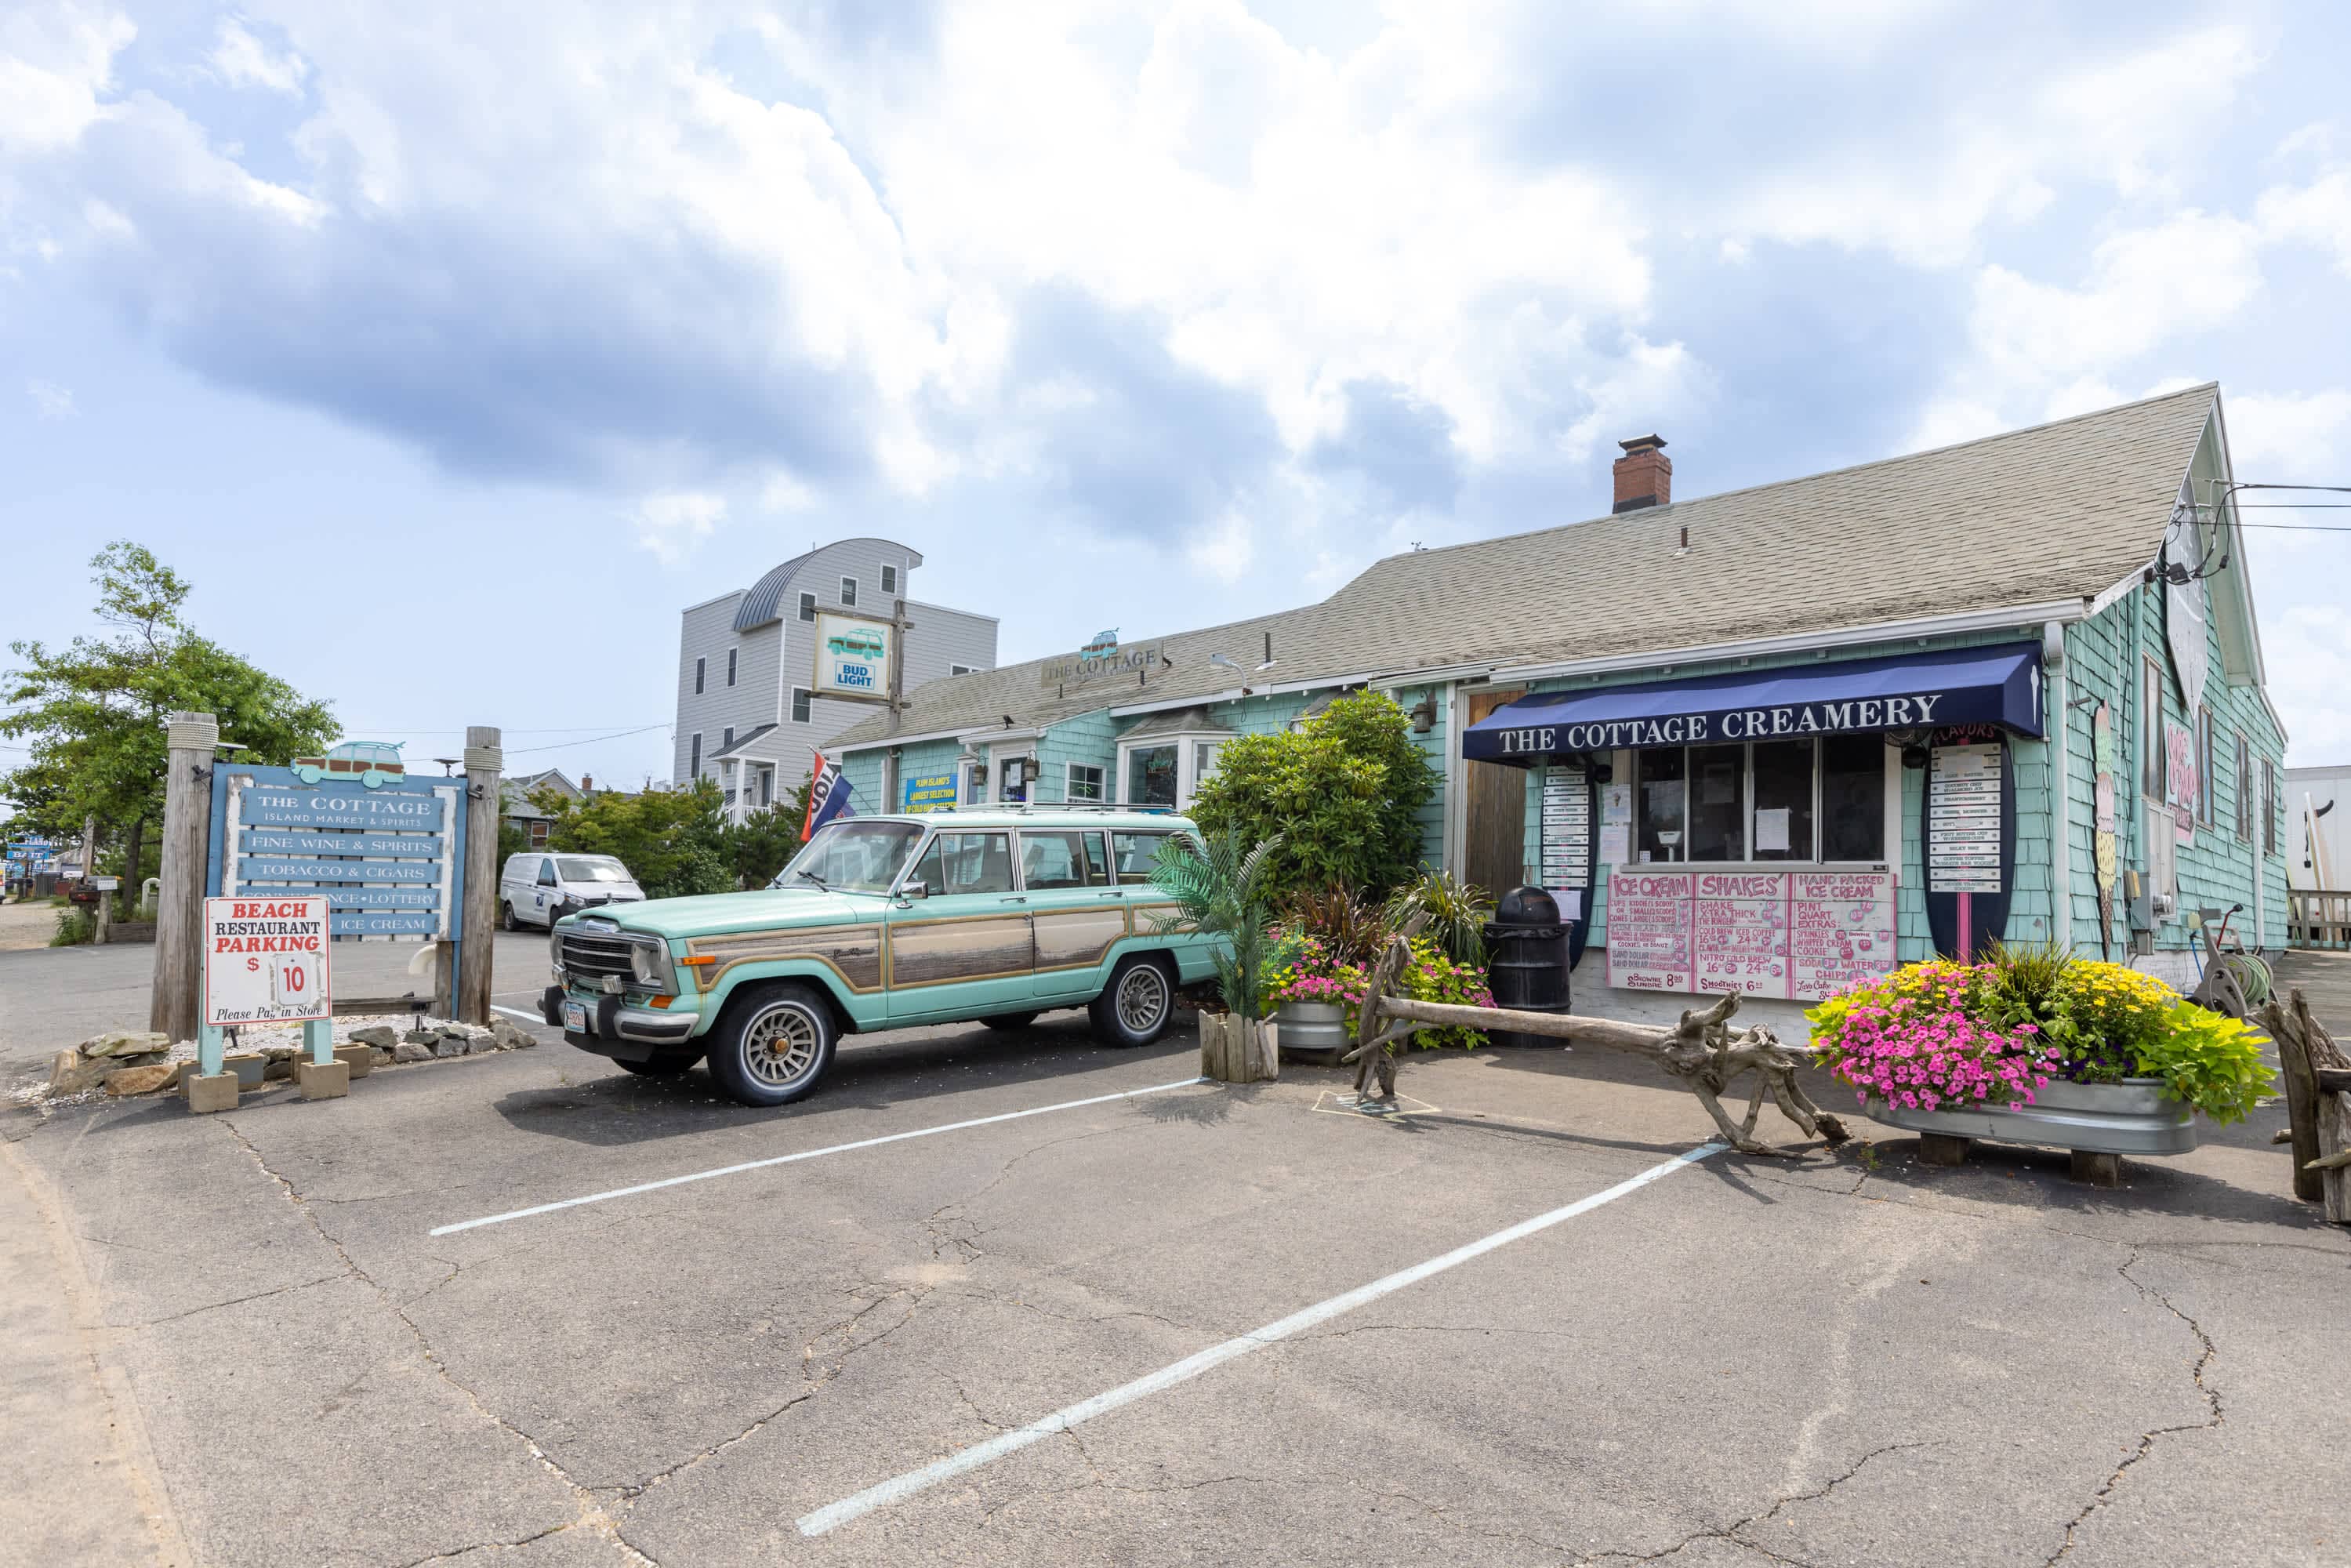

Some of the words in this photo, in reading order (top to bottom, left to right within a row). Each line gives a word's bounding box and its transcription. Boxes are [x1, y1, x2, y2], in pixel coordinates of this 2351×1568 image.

[843, 664, 868, 676] BUD
[1047, 664, 1071, 679] THE
[1076, 649, 1156, 675] COTTAGE
[837, 673, 873, 687] LIGHT
[1499, 728, 1555, 753] THE
[1568, 715, 1707, 749] COTTAGE
[1722, 695, 1942, 739] CREAMERY
[916, 779, 928, 787] PLUM
[928, 776, 950, 786] ISLAND'S
[910, 790, 929, 801] LARGEST
[929, 789, 955, 799] SELECTION
[258, 797, 299, 808] THE
[310, 797, 431, 815] COTTAGE
[265, 814, 310, 822] ISLAND
[316, 815, 364, 824] MARKET
[382, 818, 422, 826] SPIRITS
[252, 837, 293, 848] FINE
[301, 838, 346, 850] WINE
[353, 840, 364, 851] &
[372, 841, 433, 852] SPIRITS
[262, 865, 343, 877] TOBACCO
[348, 867, 358, 877] &
[366, 866, 425, 878] CIGARS
[1701, 875, 1780, 897] SHAKES
[1799, 875, 1837, 886] HAND
[1839, 875, 1885, 885] PACKED
[1640, 876, 1689, 898] CREAM
[1805, 886, 1827, 898] ICE
[1831, 885, 1874, 898] CREAM
[368, 893, 434, 905] LOTTERY
[1699, 901, 1733, 909] SHAKE
[231, 902, 308, 919] BEACH
[1798, 902, 1821, 911] PINT
[1730, 909, 1756, 918] THICK
[1798, 911, 1832, 920] QUART
[215, 921, 321, 935] RESTAURANT
[340, 919, 365, 929] ICE
[371, 919, 426, 929] CREAM
[1797, 930, 1829, 938] SPRINKLES
[215, 936, 321, 953] PARKING
[1629, 951, 1649, 960] DOLLAR
[1706, 963, 1718, 973] 16
[1746, 964, 1761, 974] 24
[1841, 960, 1874, 970] WATER
[247, 956, 259, 972] $
[283, 966, 305, 992] 10
[1634, 973, 1663, 983] BROWNIE
[1816, 970, 1846, 980] CHIPS
[1627, 976, 1663, 988] SUNDAE
[216, 1007, 252, 1021] Please
[281, 1007, 292, 1017] in
[296, 1004, 322, 1017] Store
